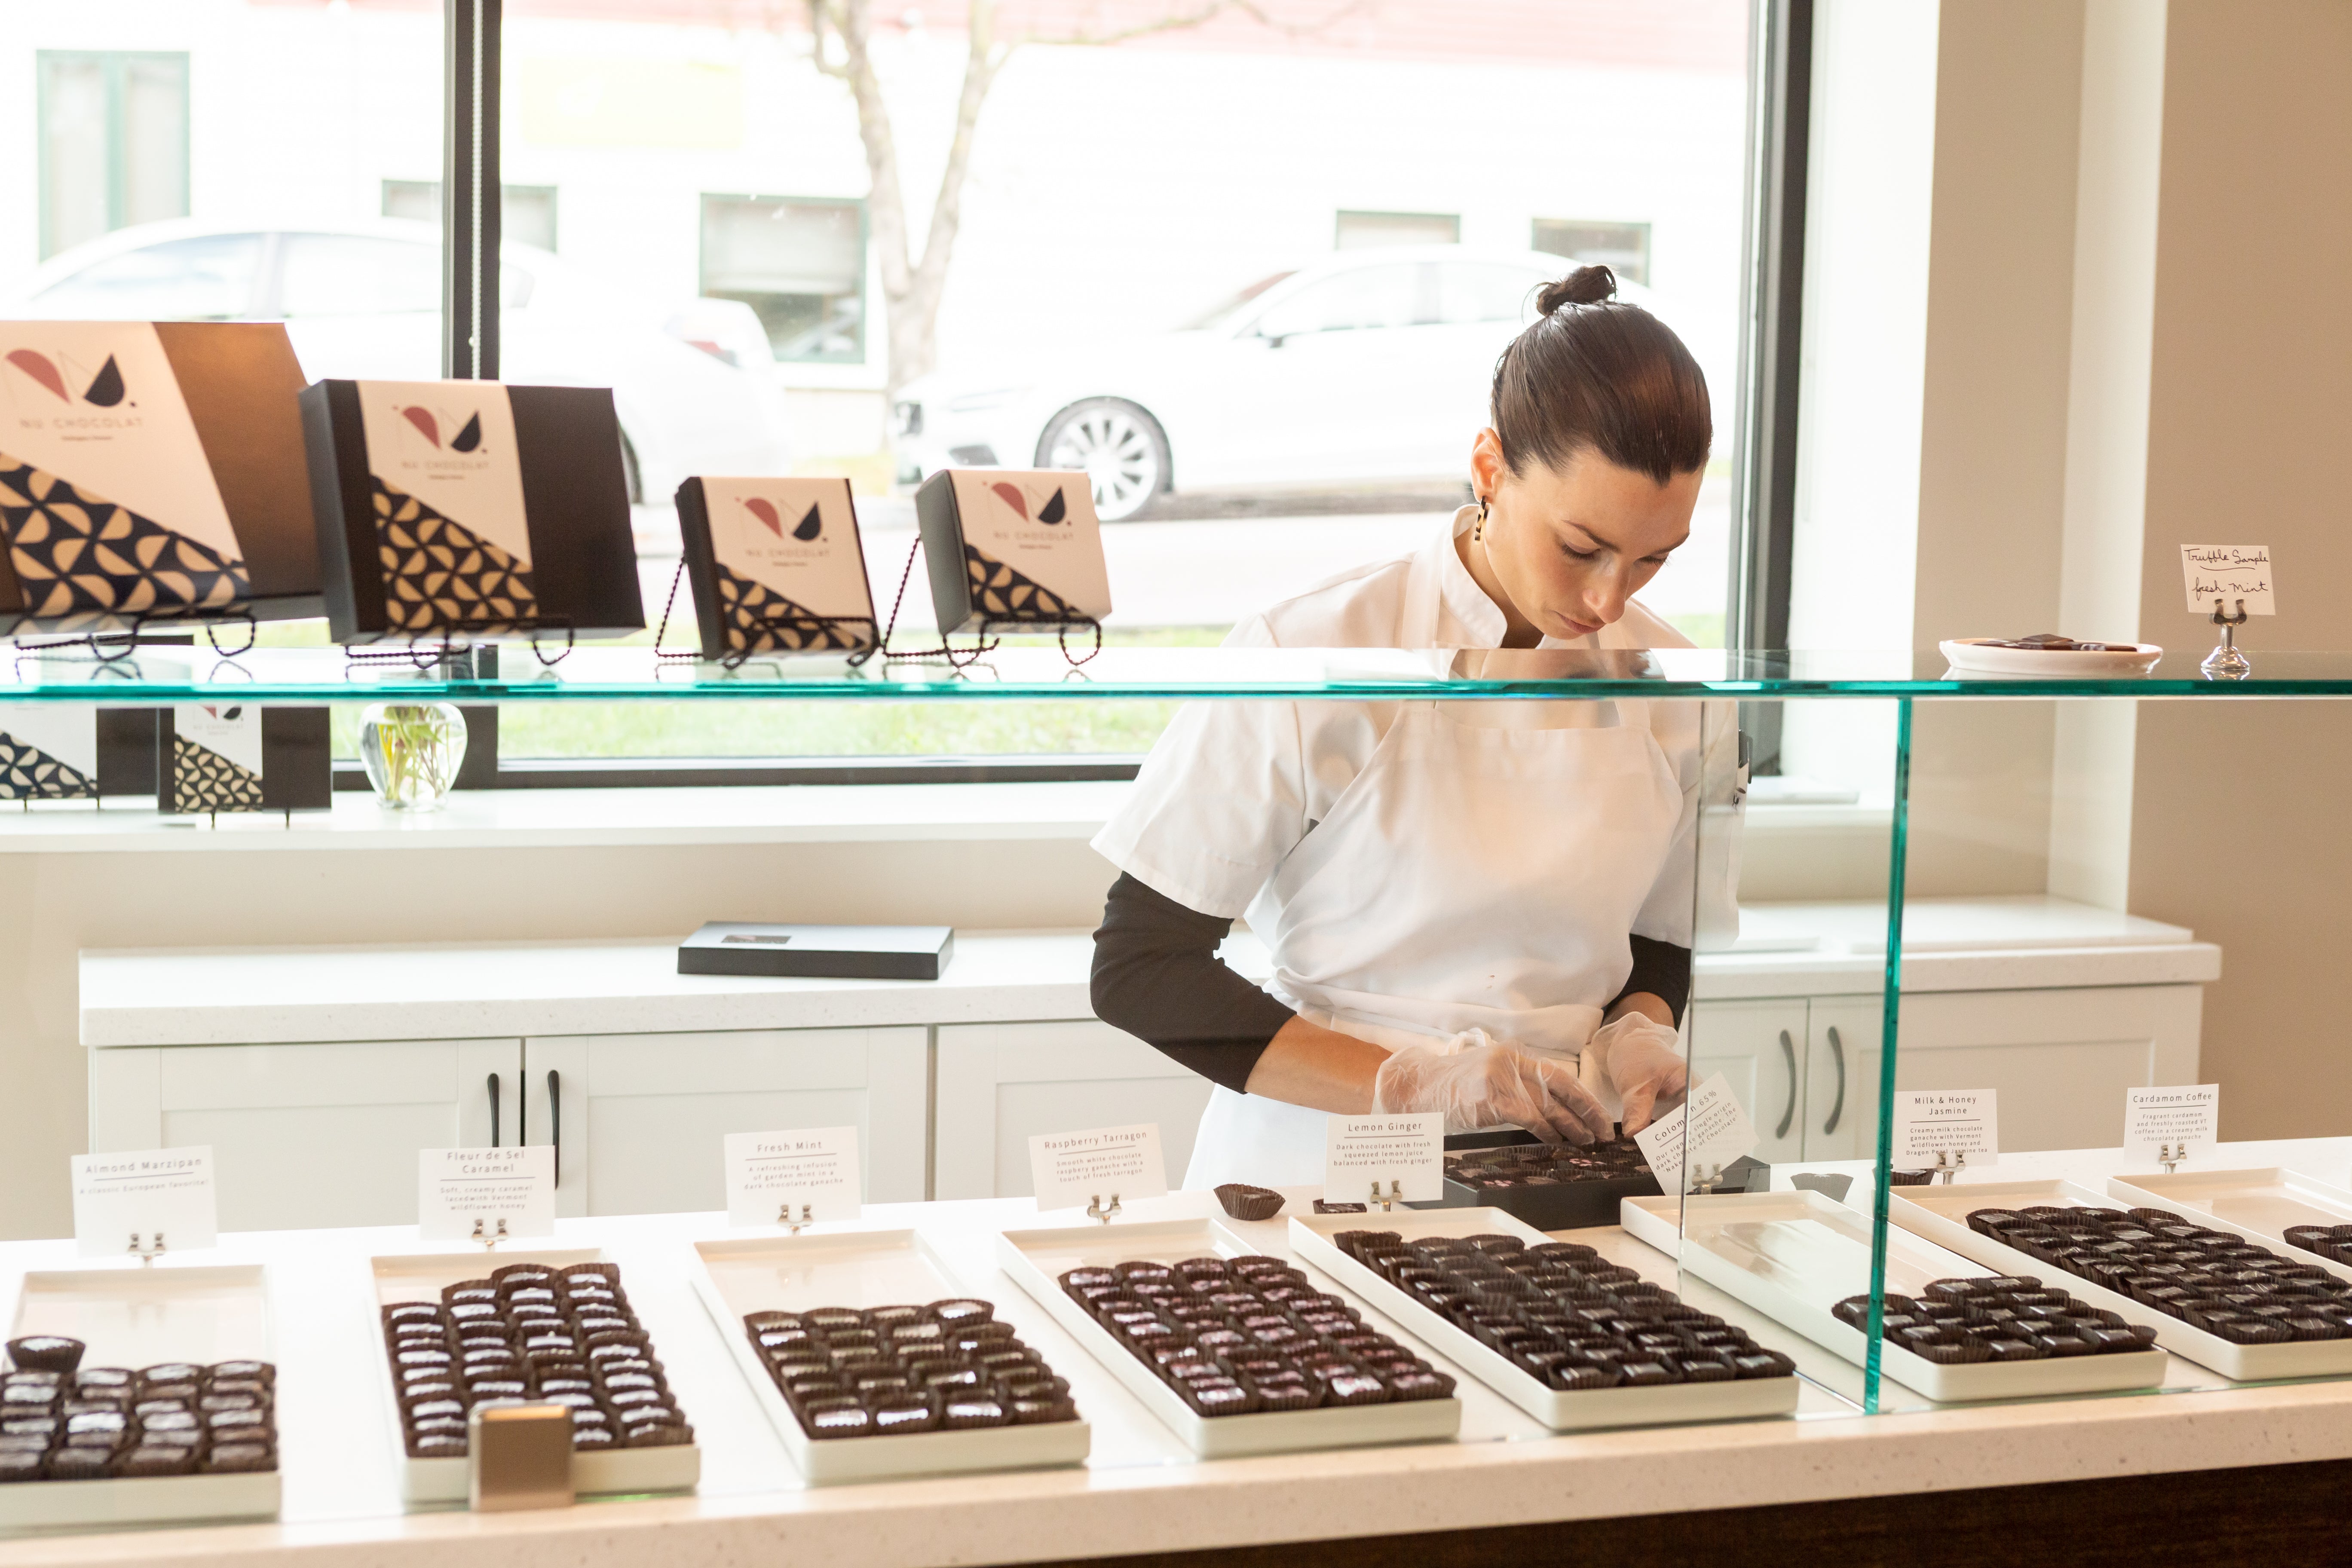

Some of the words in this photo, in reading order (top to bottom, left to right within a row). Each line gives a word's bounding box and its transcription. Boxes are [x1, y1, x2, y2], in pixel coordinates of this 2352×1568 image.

[2184, 548, 2229, 564] Truffle
[2232, 549, 2269, 565] Sample
[2228, 580, 2268, 592] Mint
[2187, 1093, 2211, 1101] Coffee
[1655, 1106, 1696, 1141] Colomn
[1699, 1090, 1717, 1106] 65%
[1348, 1124, 1383, 1132] Lemon
[1388, 1122, 1422, 1132] Ginger
[1656, 1152, 1668, 1161] Our
[1694, 1117, 1712, 1131] single
[1714, 1102, 1731, 1117] origin
[1045, 1137, 1099, 1149] Raspberry
[1103, 1131, 1147, 1142] Tarragon
[1656, 1159, 1671, 1170] dark
[1725, 1107, 1736, 1117] The
[757, 1142, 790, 1152] Fresh
[796, 1141, 822, 1149] Mint
[447, 1152, 480, 1160] Fleur
[486, 1152, 500, 1160] de
[506, 1150, 525, 1159] Sel
[86, 1163, 135, 1174] Almond
[141, 1158, 202, 1170] Marzipan
[462, 1164, 514, 1173] Caramel
[1092, 1163, 1120, 1171] ganache
[1663, 1160, 1685, 1173] 'Nake
[765, 1172, 793, 1181] garden
[810, 1178, 843, 1186] ganache
